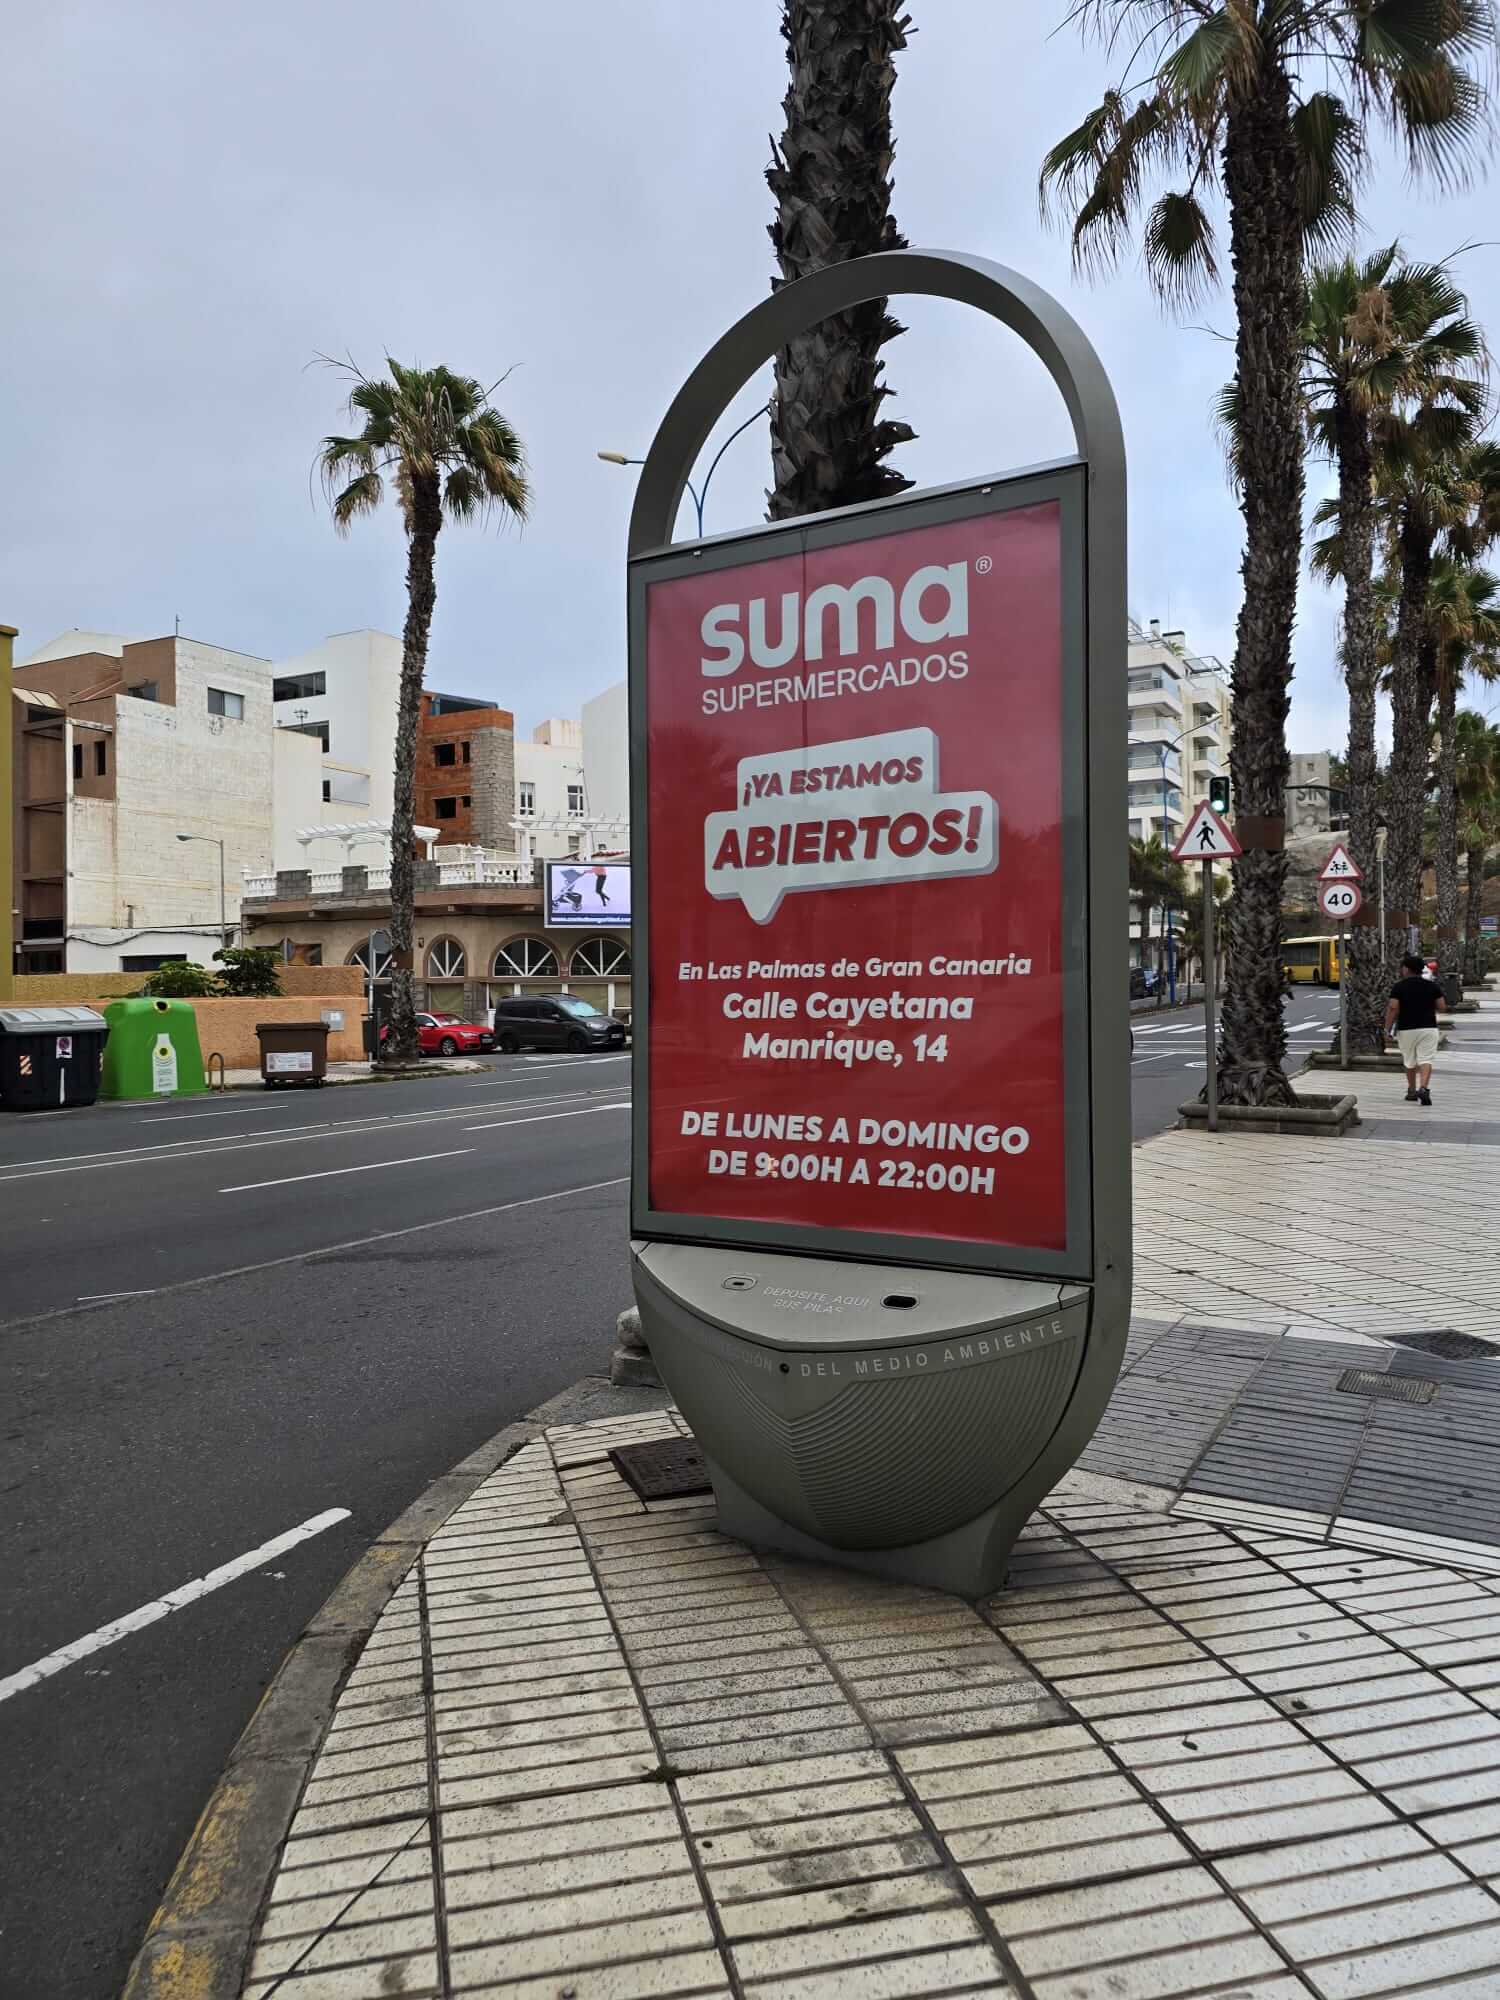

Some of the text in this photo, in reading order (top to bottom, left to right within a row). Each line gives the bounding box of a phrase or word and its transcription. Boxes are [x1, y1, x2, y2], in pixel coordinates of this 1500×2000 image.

[701, 560, 969, 678] suma
[701, 650, 969, 715] SUPERMERCADOS
[743, 756, 923, 806] ¡YA ESTAMOS
[712, 806, 984, 872] ABIERTOS!
[1328, 893, 1352, 906] 40
[678, 953, 1032, 980] En Las Palmas de Gran Canaria
[723, 990, 974, 1026] Calle Cayetana
[742, 1031, 948, 1068] Manrique, 14
[681, 1111, 1030, 1155] DE LUNES A DOMINGO
[708, 1150, 995, 1195] DE 9:00H A 22:00H
[801, 1320, 1065, 1377] DEL MEDIO AMBIENTE
